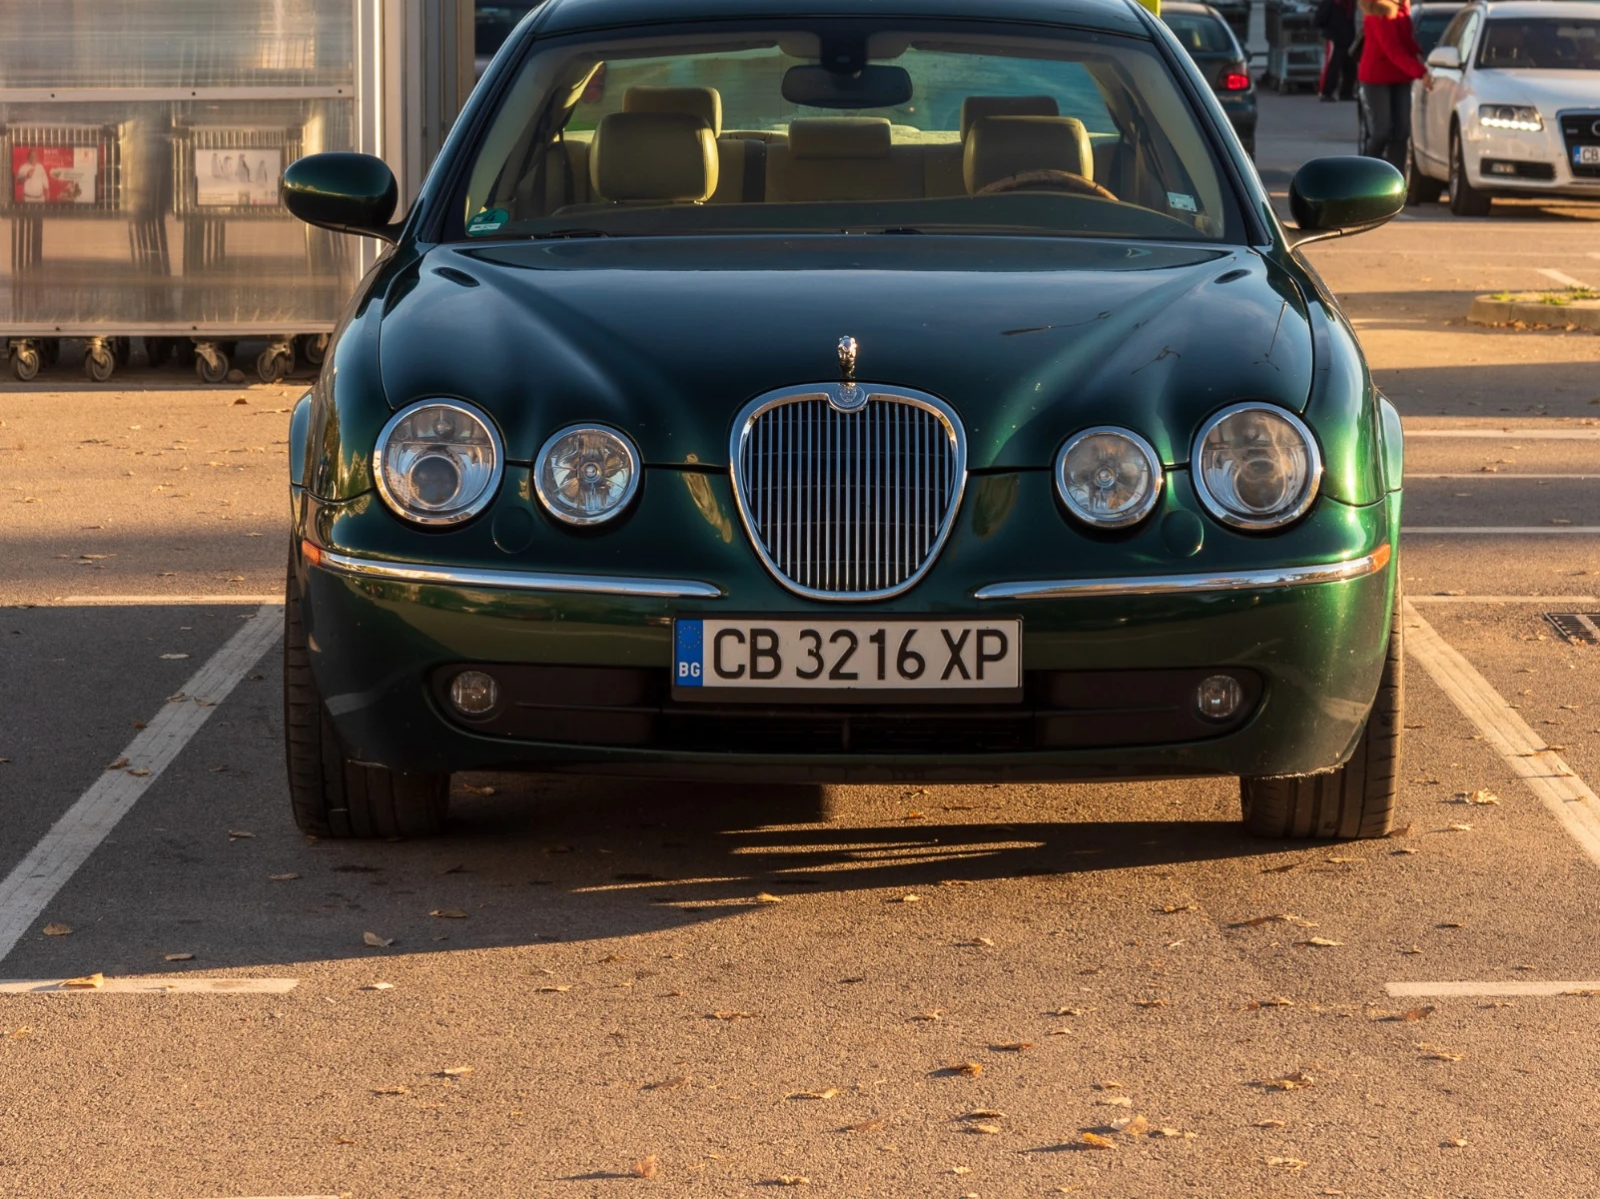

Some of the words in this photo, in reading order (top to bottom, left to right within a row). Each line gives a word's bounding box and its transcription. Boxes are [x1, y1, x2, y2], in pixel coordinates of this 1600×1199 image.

[678, 662, 701, 678] BG
[713, 628, 782, 680] CB
[796, 629, 926, 681] 3216
[940, 629, 1009, 681] XP
